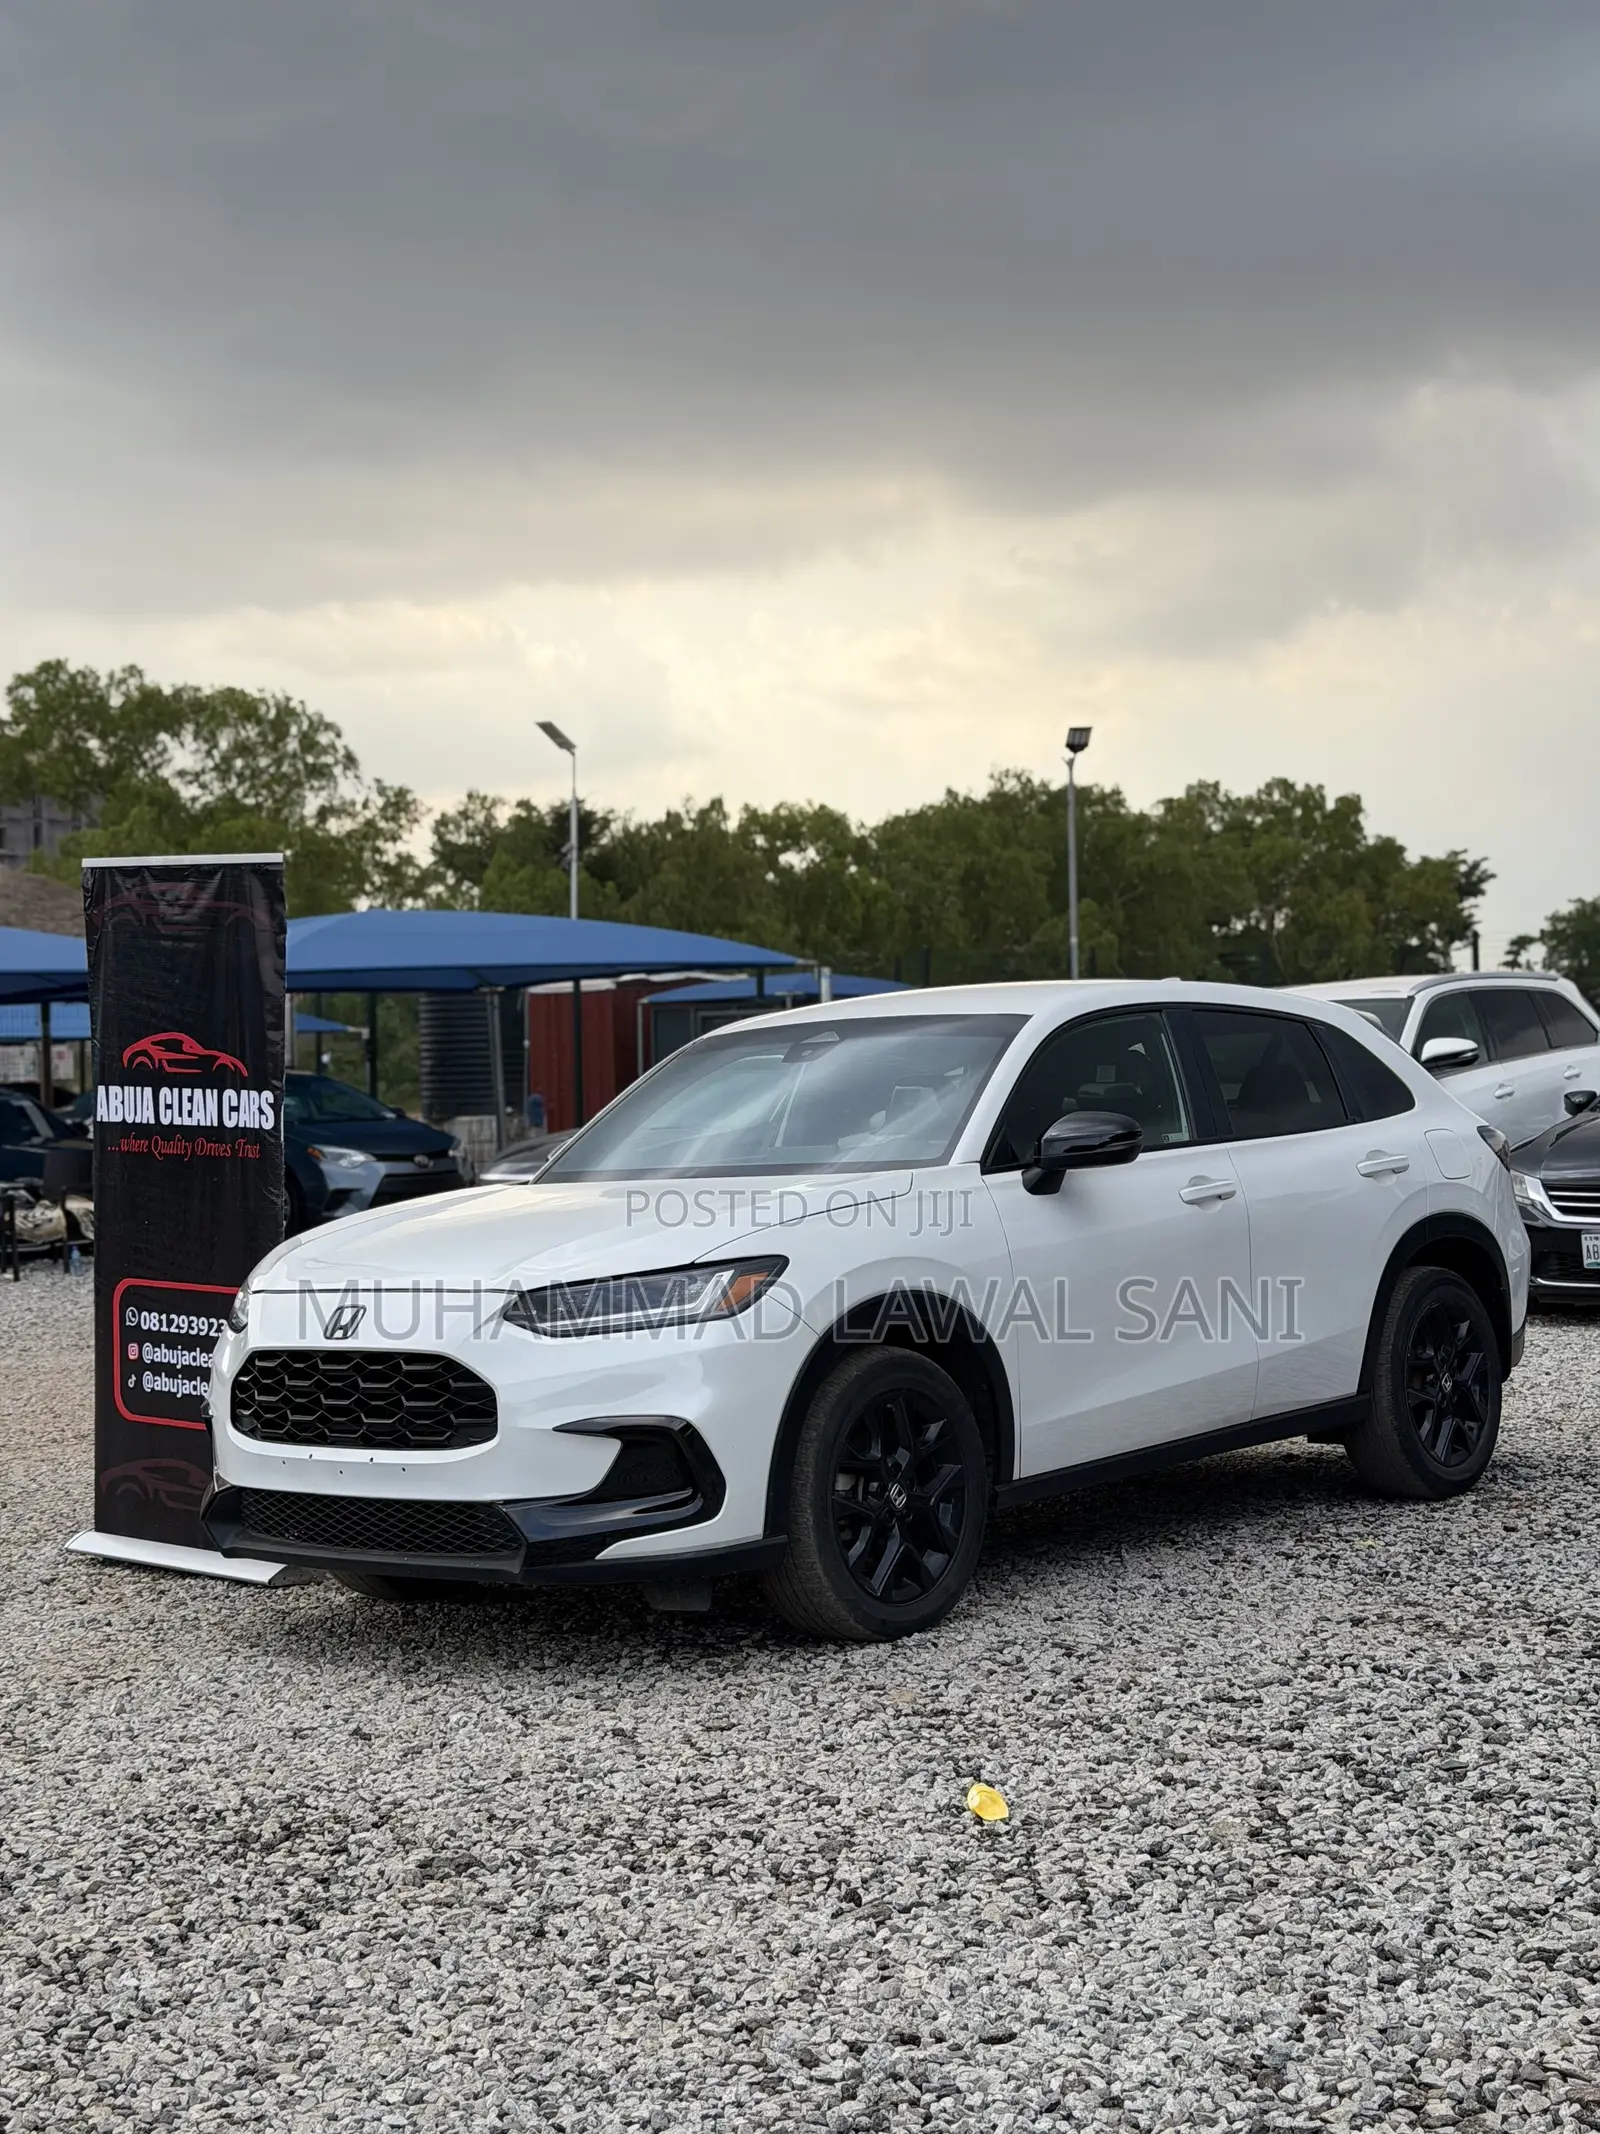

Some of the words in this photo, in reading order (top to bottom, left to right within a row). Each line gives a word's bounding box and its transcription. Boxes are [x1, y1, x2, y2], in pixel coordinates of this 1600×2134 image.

[96, 1085, 155, 1125] ABUJA
[159, 1086, 218, 1127] CLEAN
[222, 1089, 275, 1130] CARS
[108, 1132, 149, 1153] ...where
[151, 1132, 192, 1161] Quality
[195, 1137, 232, 1157] Drives
[235, 1137, 261, 1159] Trust
